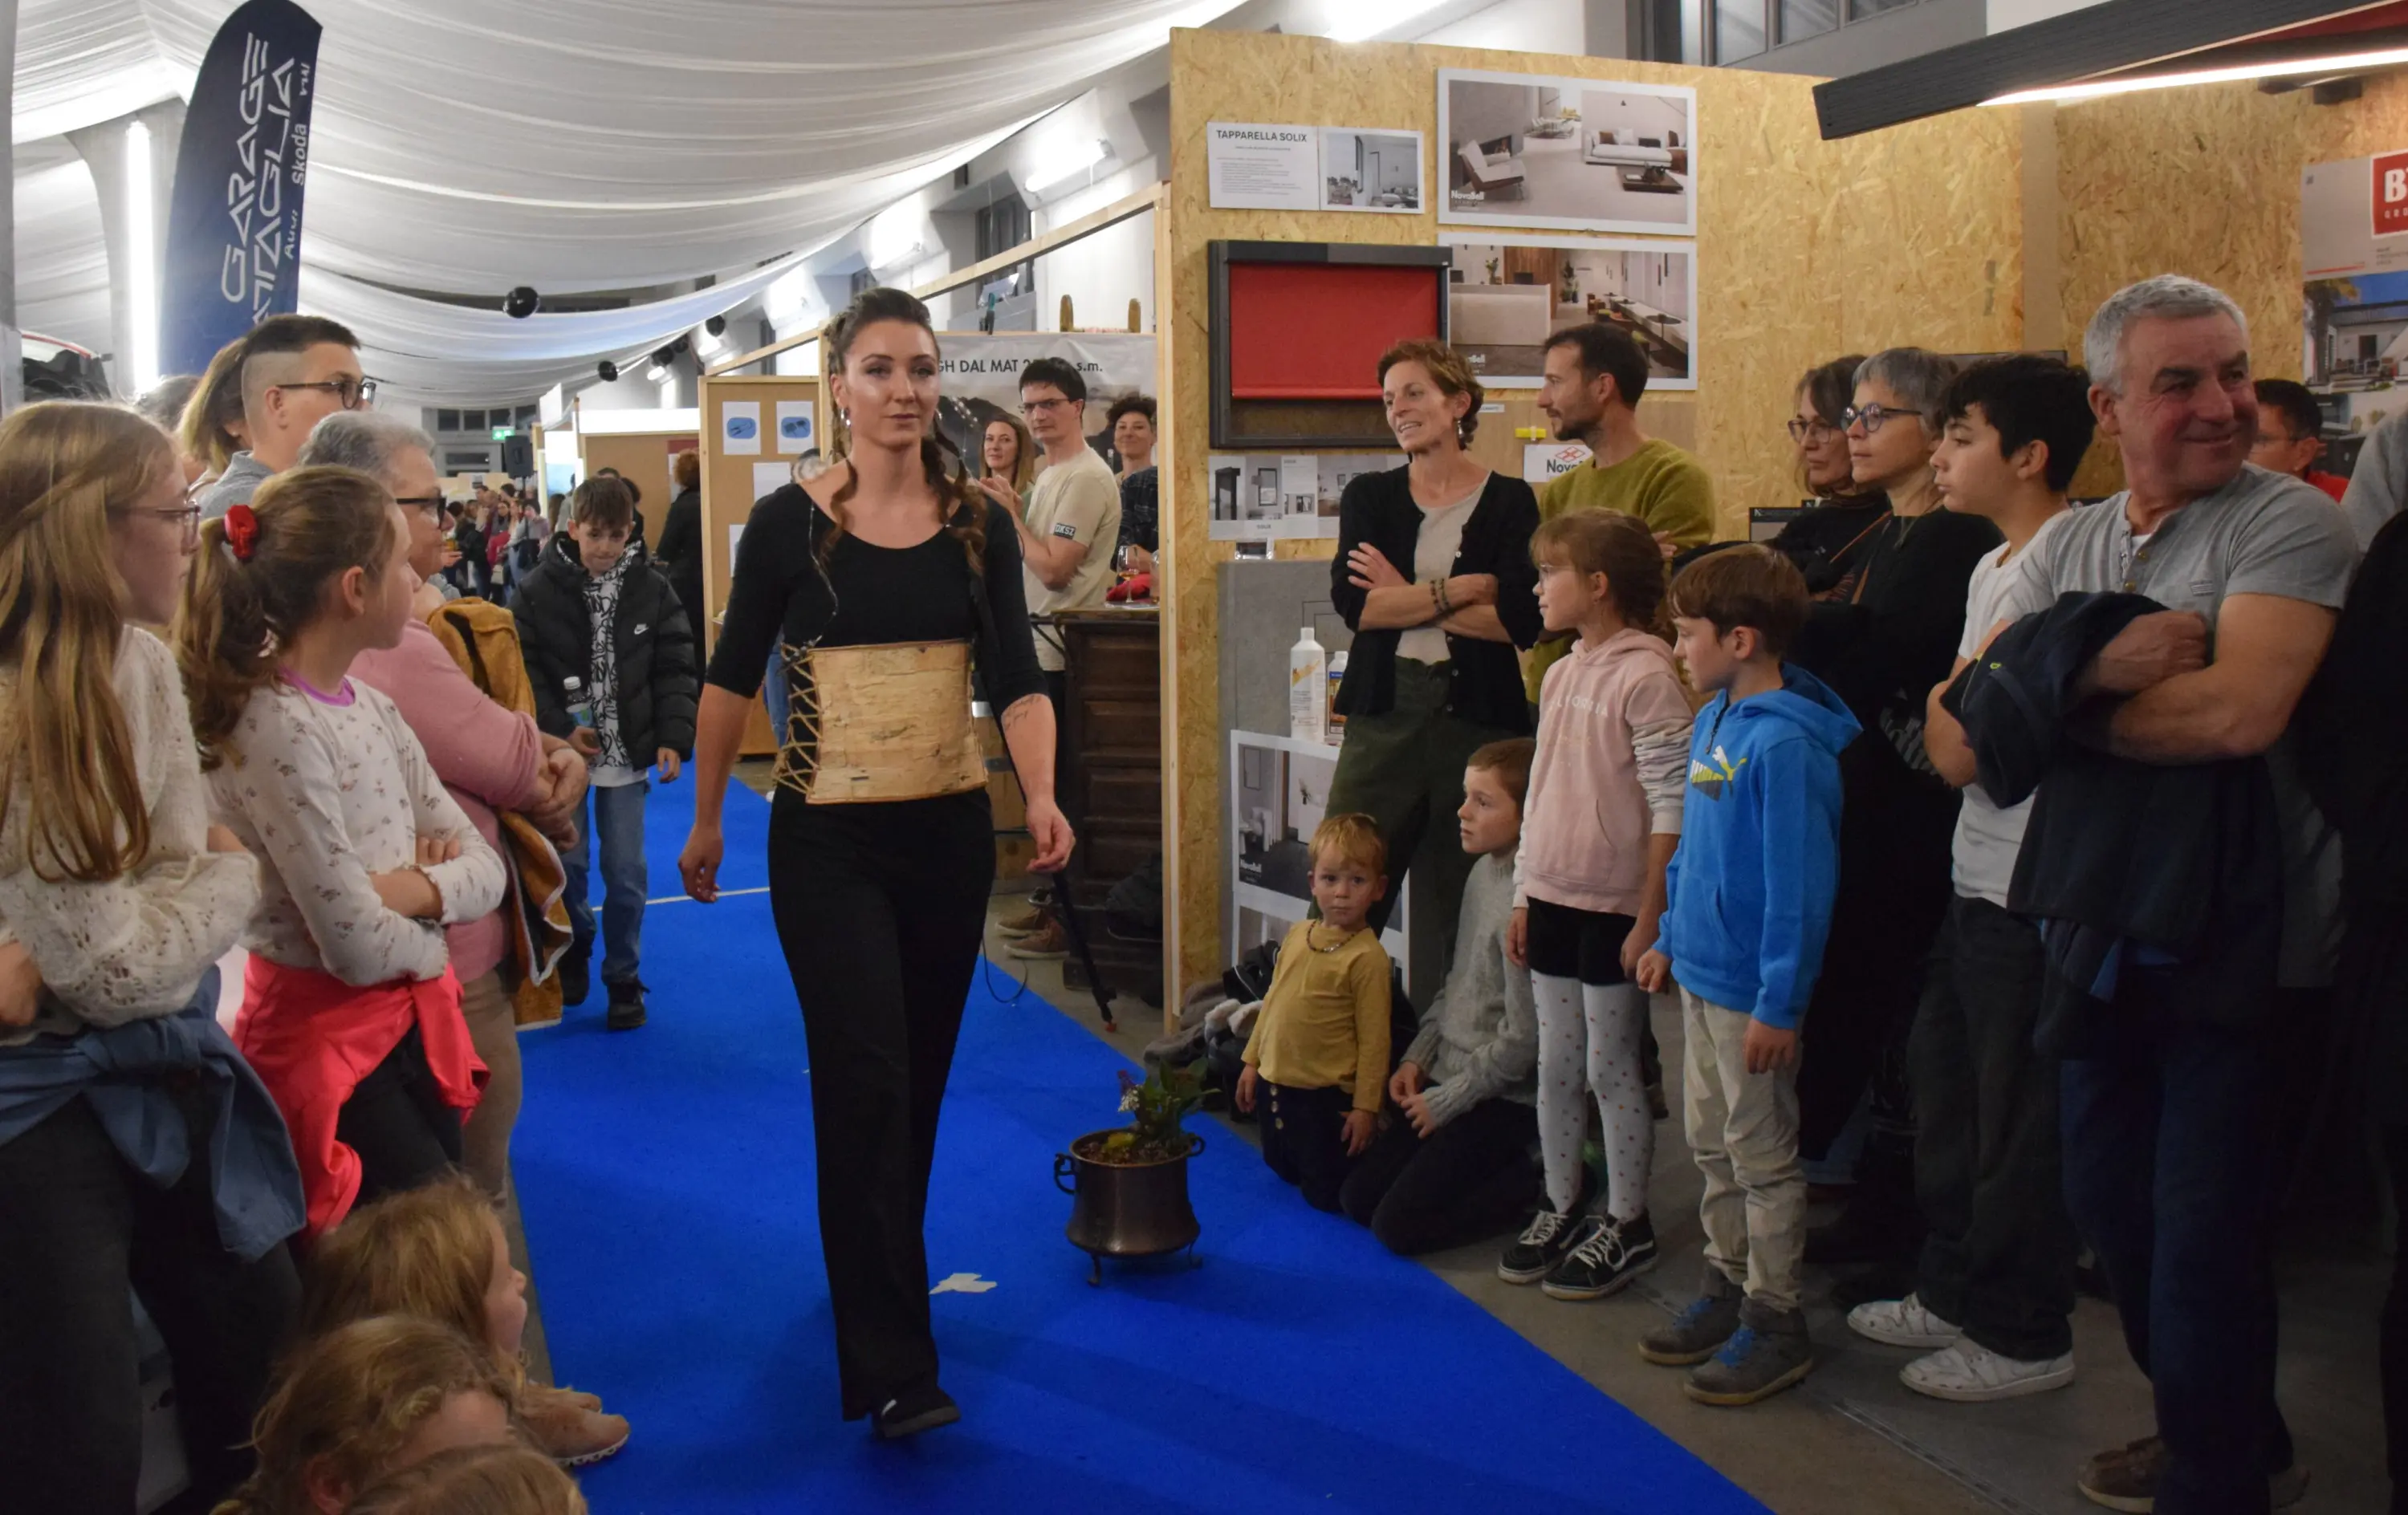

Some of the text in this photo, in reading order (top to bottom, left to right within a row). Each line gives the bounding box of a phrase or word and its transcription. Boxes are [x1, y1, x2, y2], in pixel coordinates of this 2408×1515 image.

[1216, 130, 1308, 143] TAPPARELLA SOLIX
[222, 32, 269, 302] GARAGE
[291, 124, 308, 186] Skoda
[2385, 169, 2408, 203] B
[959, 359, 986, 373] DAL
[990, 359, 1019, 372] MAT
